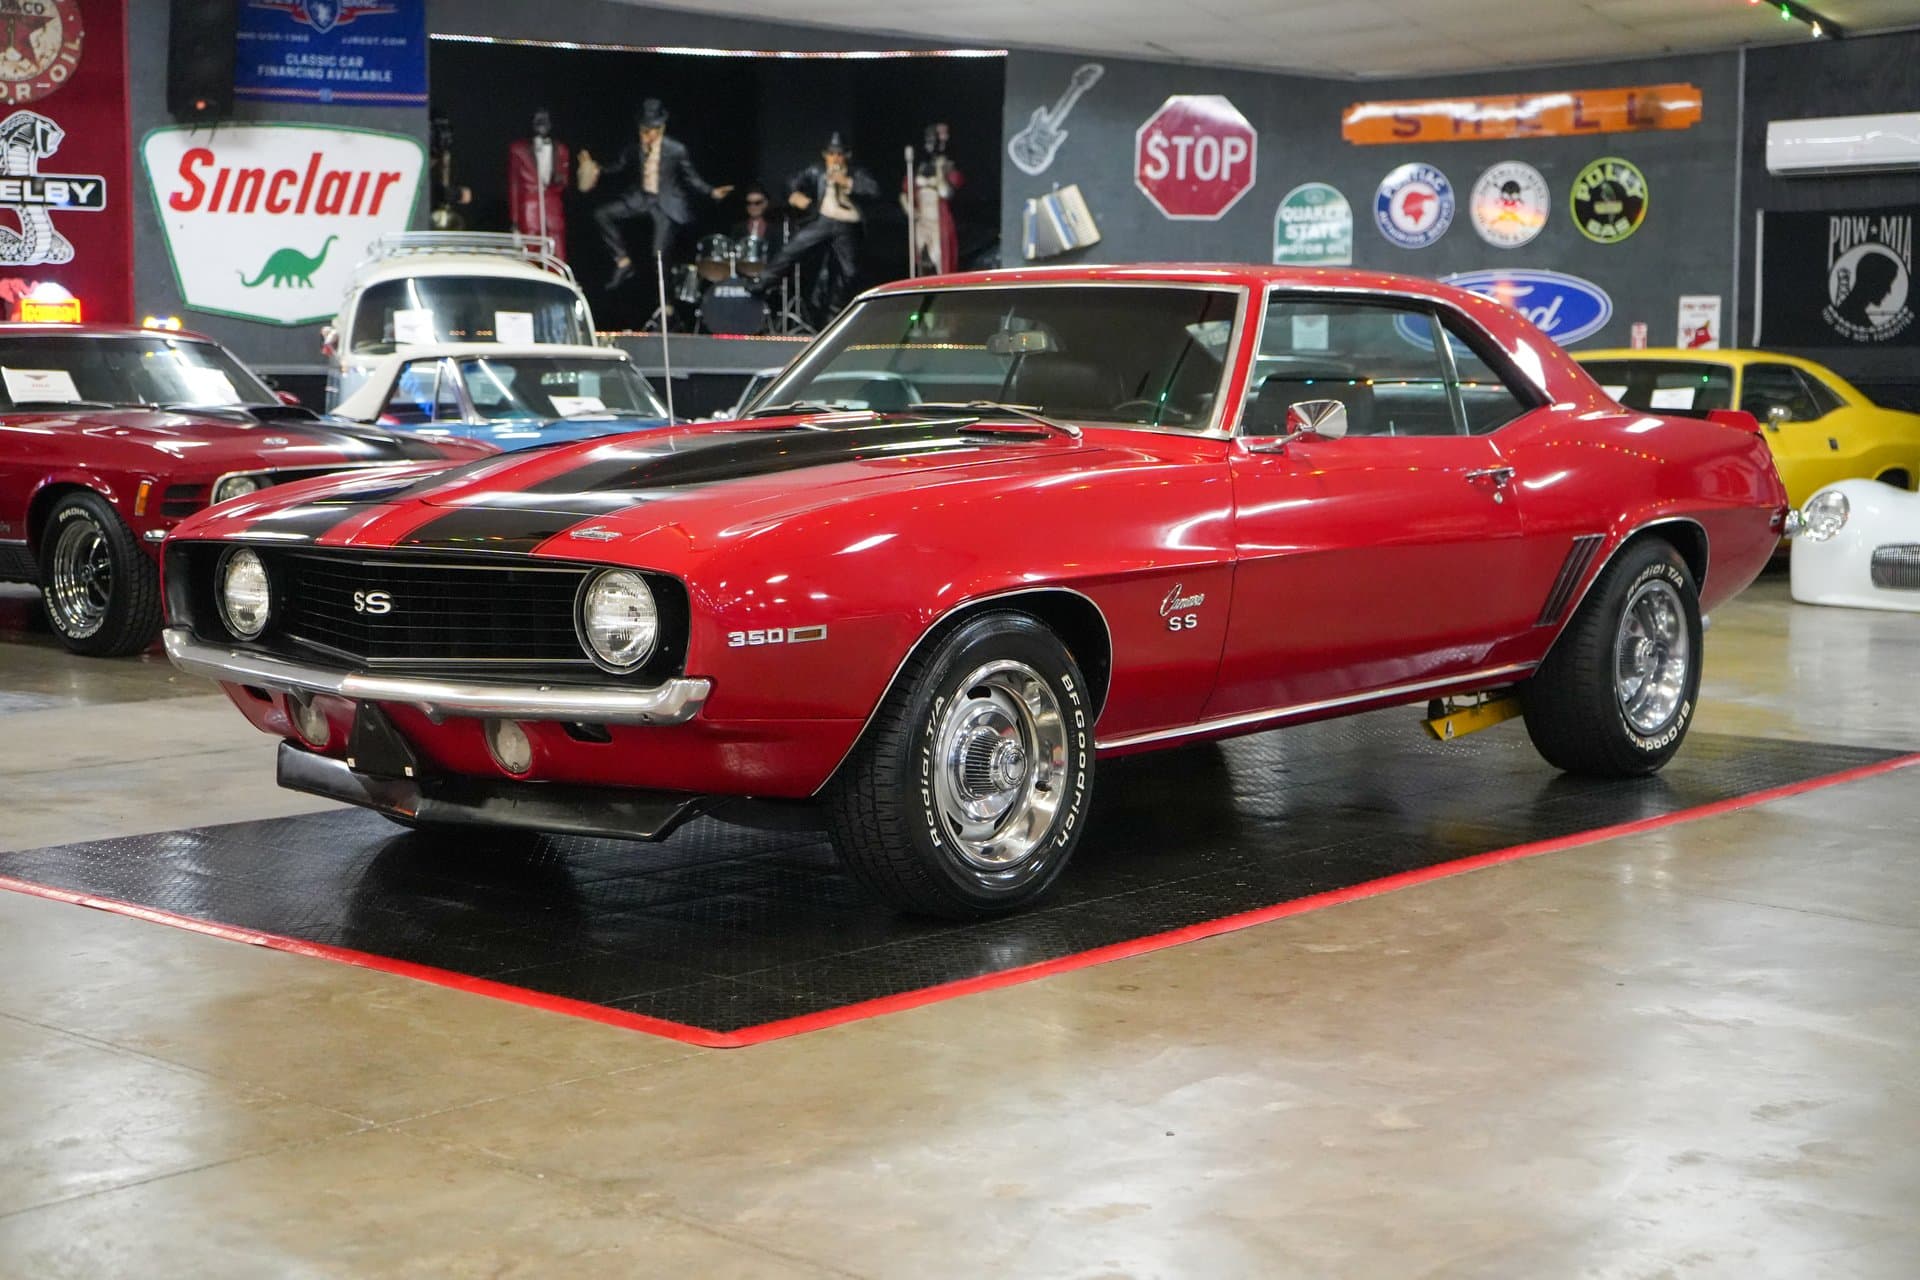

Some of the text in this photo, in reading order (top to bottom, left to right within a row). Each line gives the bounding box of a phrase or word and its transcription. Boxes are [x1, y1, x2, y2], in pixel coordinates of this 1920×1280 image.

[285, 53, 364, 69] CLASSIC CAR
[257, 65, 393, 83] FINANCING AVAILABLE
[1144, 134, 1248, 181] STOP
[168, 147, 402, 216] Sinclair
[1381, 164, 1446, 196] PTIAC
[0, 180, 97, 204] ELBY
[1586, 218, 1630, 236] GAS
[1828, 216, 1912, 275] POW MIA
[59, 507, 91, 522] RADIAL
[1668, 566, 1684, 590] T/A
[354, 591, 392, 614] SS
[1169, 613, 1198, 631] SS
[727, 627, 784, 647] 350
[926, 696, 945, 738] T/A
